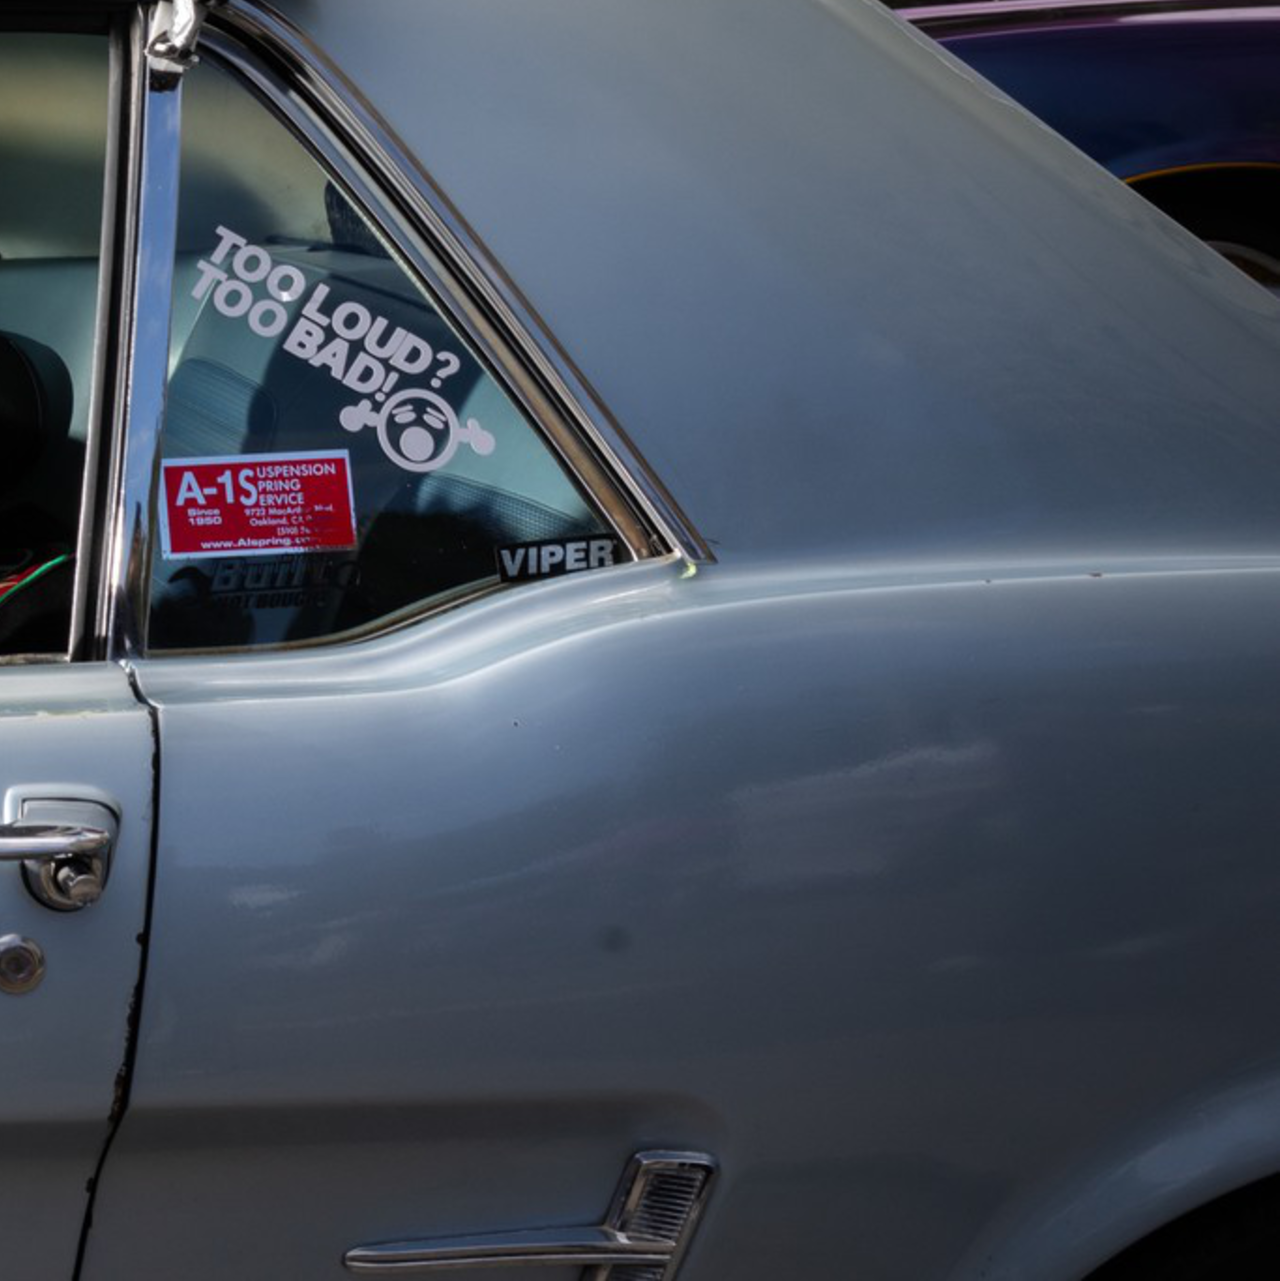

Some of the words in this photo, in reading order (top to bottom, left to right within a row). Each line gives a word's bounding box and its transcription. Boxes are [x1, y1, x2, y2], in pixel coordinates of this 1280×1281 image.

[189, 260, 289, 338] TOO
[283, 319, 398, 402] BAD!
[213, 225, 306, 302] TOO
[301, 283, 461, 388] LOUD?
[500, 540, 614, 577] VIPER
